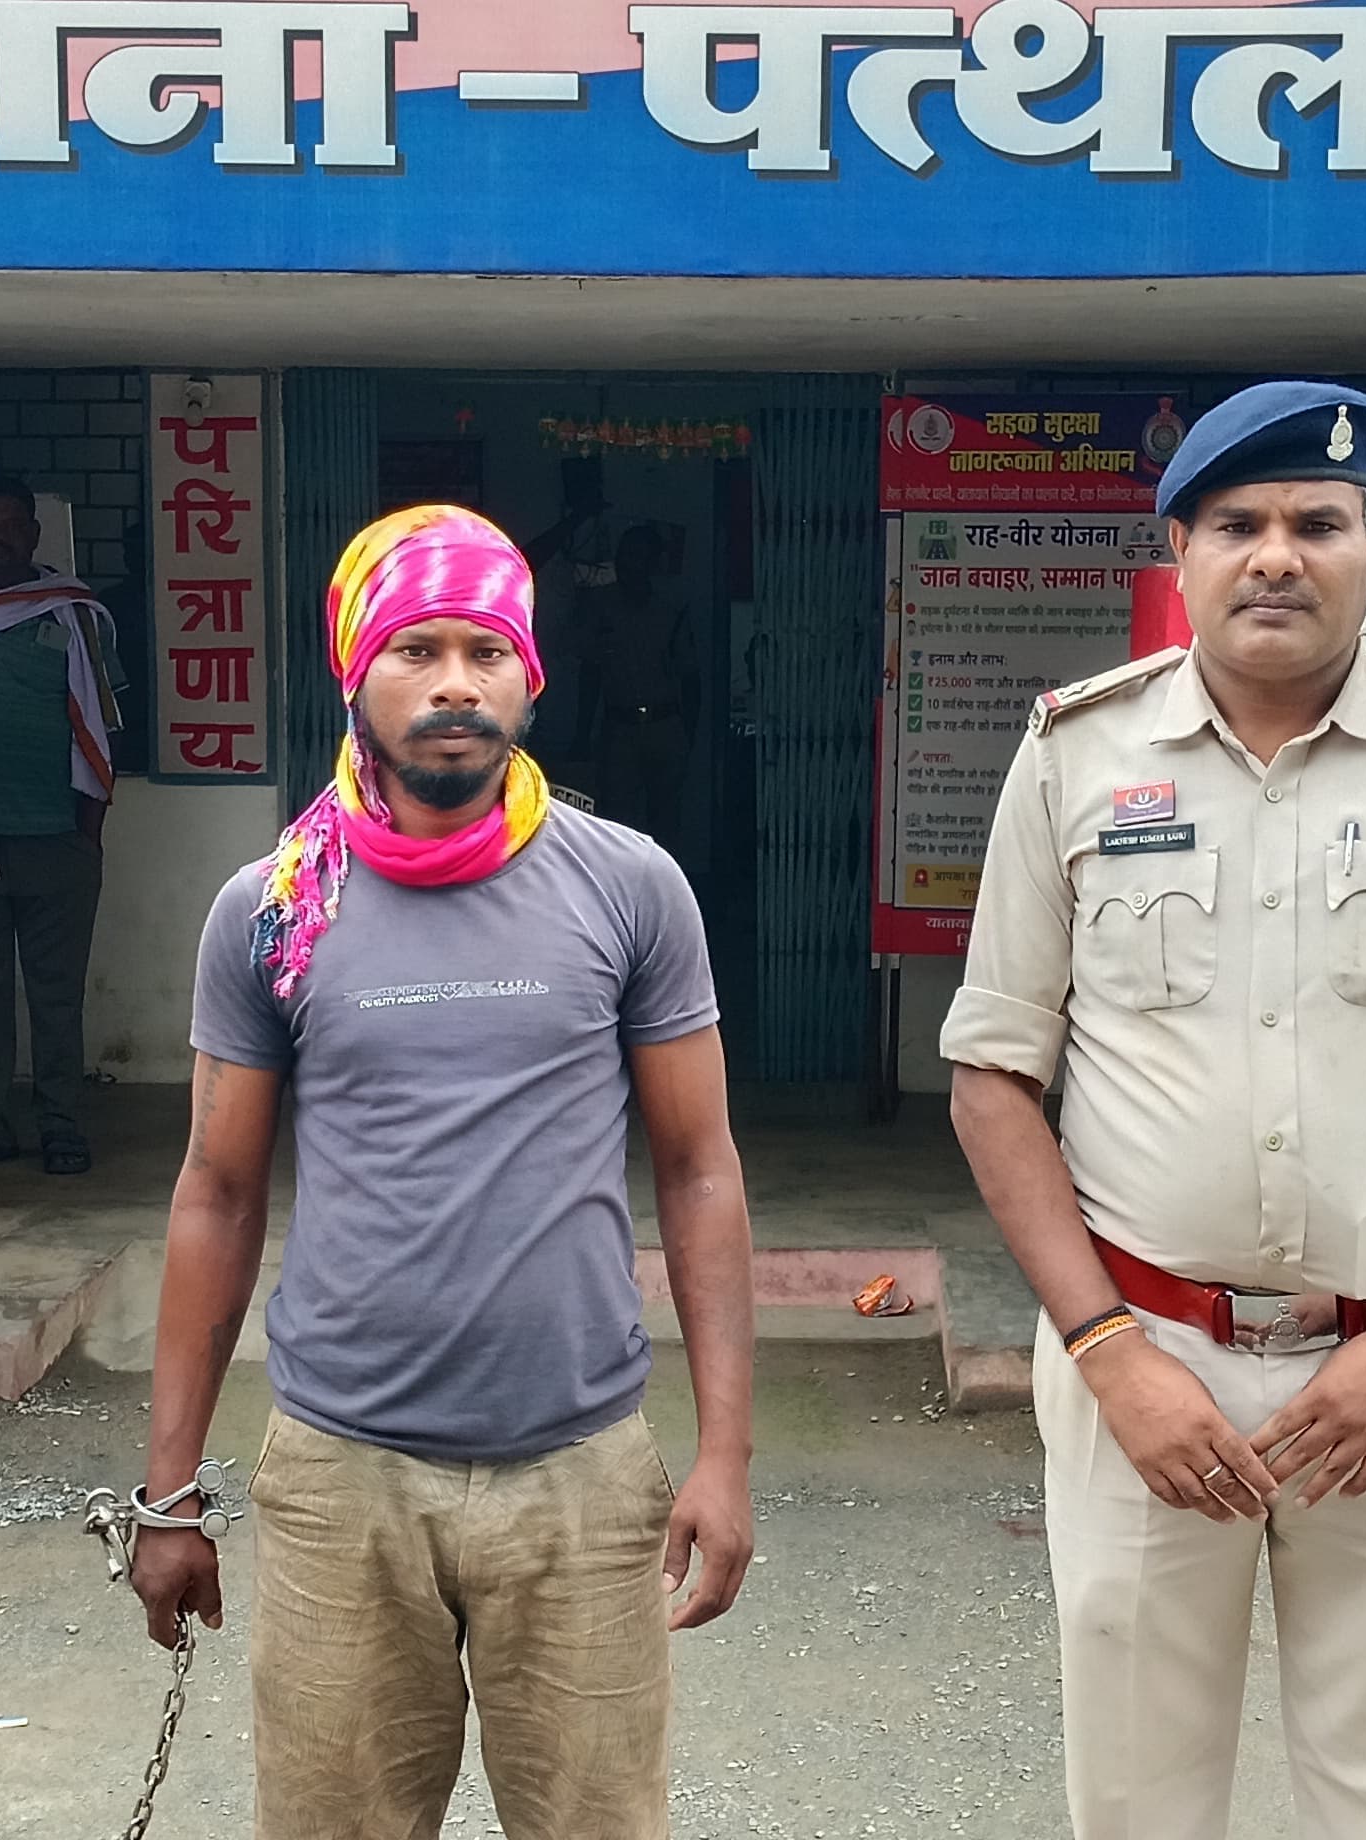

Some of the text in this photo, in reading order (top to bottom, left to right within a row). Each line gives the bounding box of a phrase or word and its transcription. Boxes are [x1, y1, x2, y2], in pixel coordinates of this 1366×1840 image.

[985, 412, 1101, 442] सड़क सुरक्षा
[949, 443, 1136, 473] जागरूकता अभियान
[964, 519, 1120, 548] राह-वीर योजना
[967, 567, 1035, 592] बचाइए,
[1041, 567, 1106, 590] सम्मान
[1113, 568, 1134, 589] पा
[927, 653, 955, 667] इनाम
[958, 651, 977, 666] और
[926, 916, 970, 929] याताया
